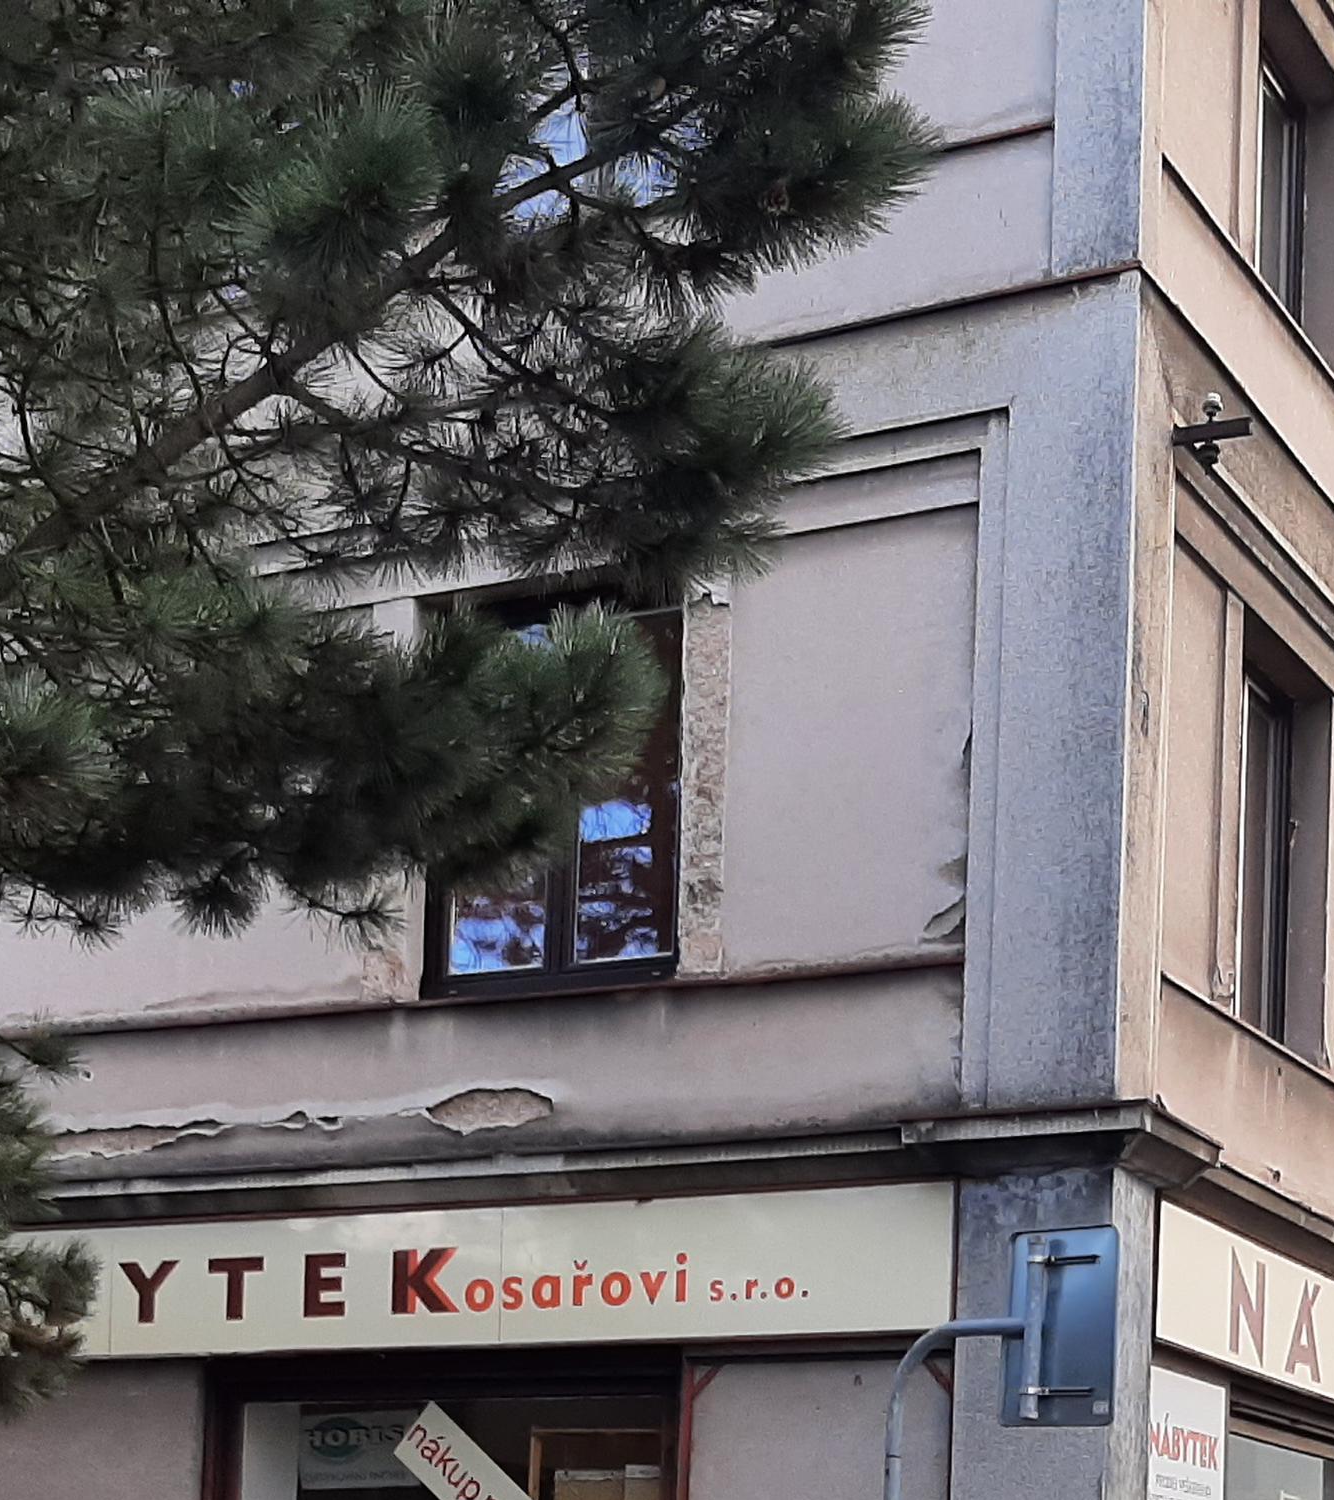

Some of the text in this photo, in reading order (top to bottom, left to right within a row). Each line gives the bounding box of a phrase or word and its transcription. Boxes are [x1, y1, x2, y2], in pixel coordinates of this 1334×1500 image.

[709, 1276, 809, 1302] s.r.o.
[407, 1424, 481, 1500] nákup
[1149, 1412, 1218, 1471] NÁBYTEK
